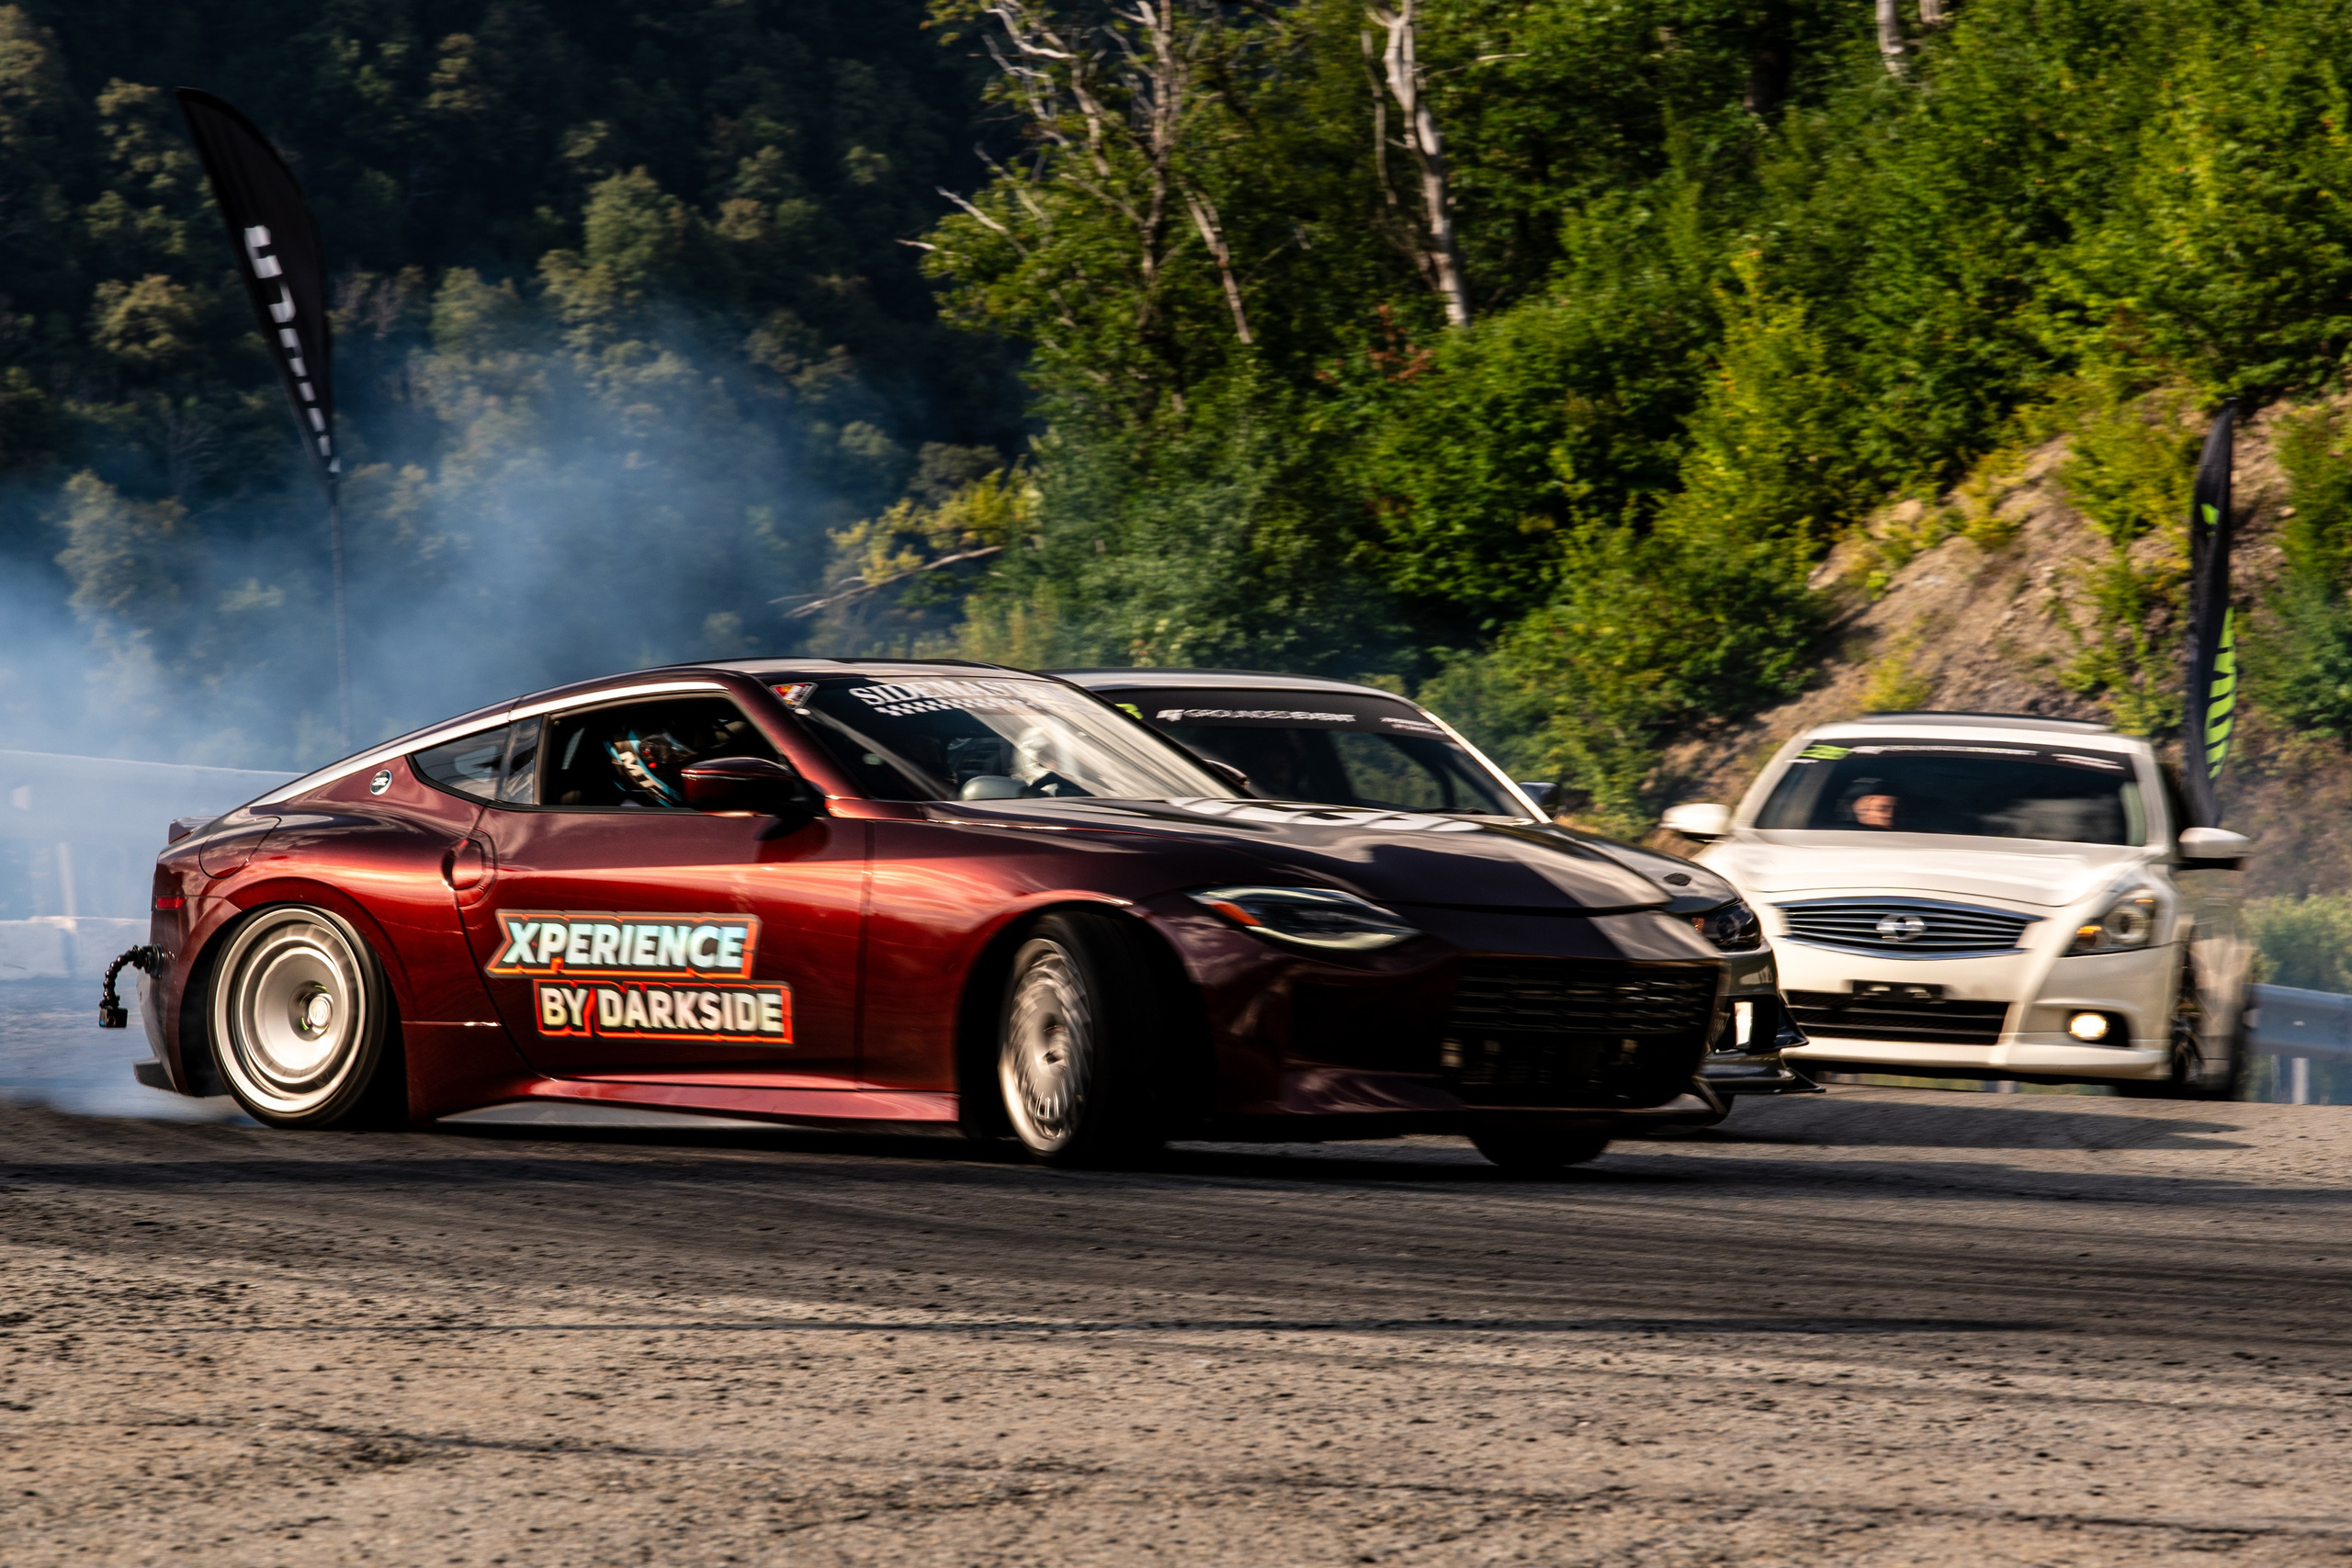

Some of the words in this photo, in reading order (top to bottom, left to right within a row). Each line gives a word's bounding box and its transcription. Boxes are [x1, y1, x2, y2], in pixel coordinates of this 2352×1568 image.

[502, 921, 748, 968] XPERIENCE
[540, 987, 588, 1027] BY
[597, 987, 785, 1033] DARKSIDE
